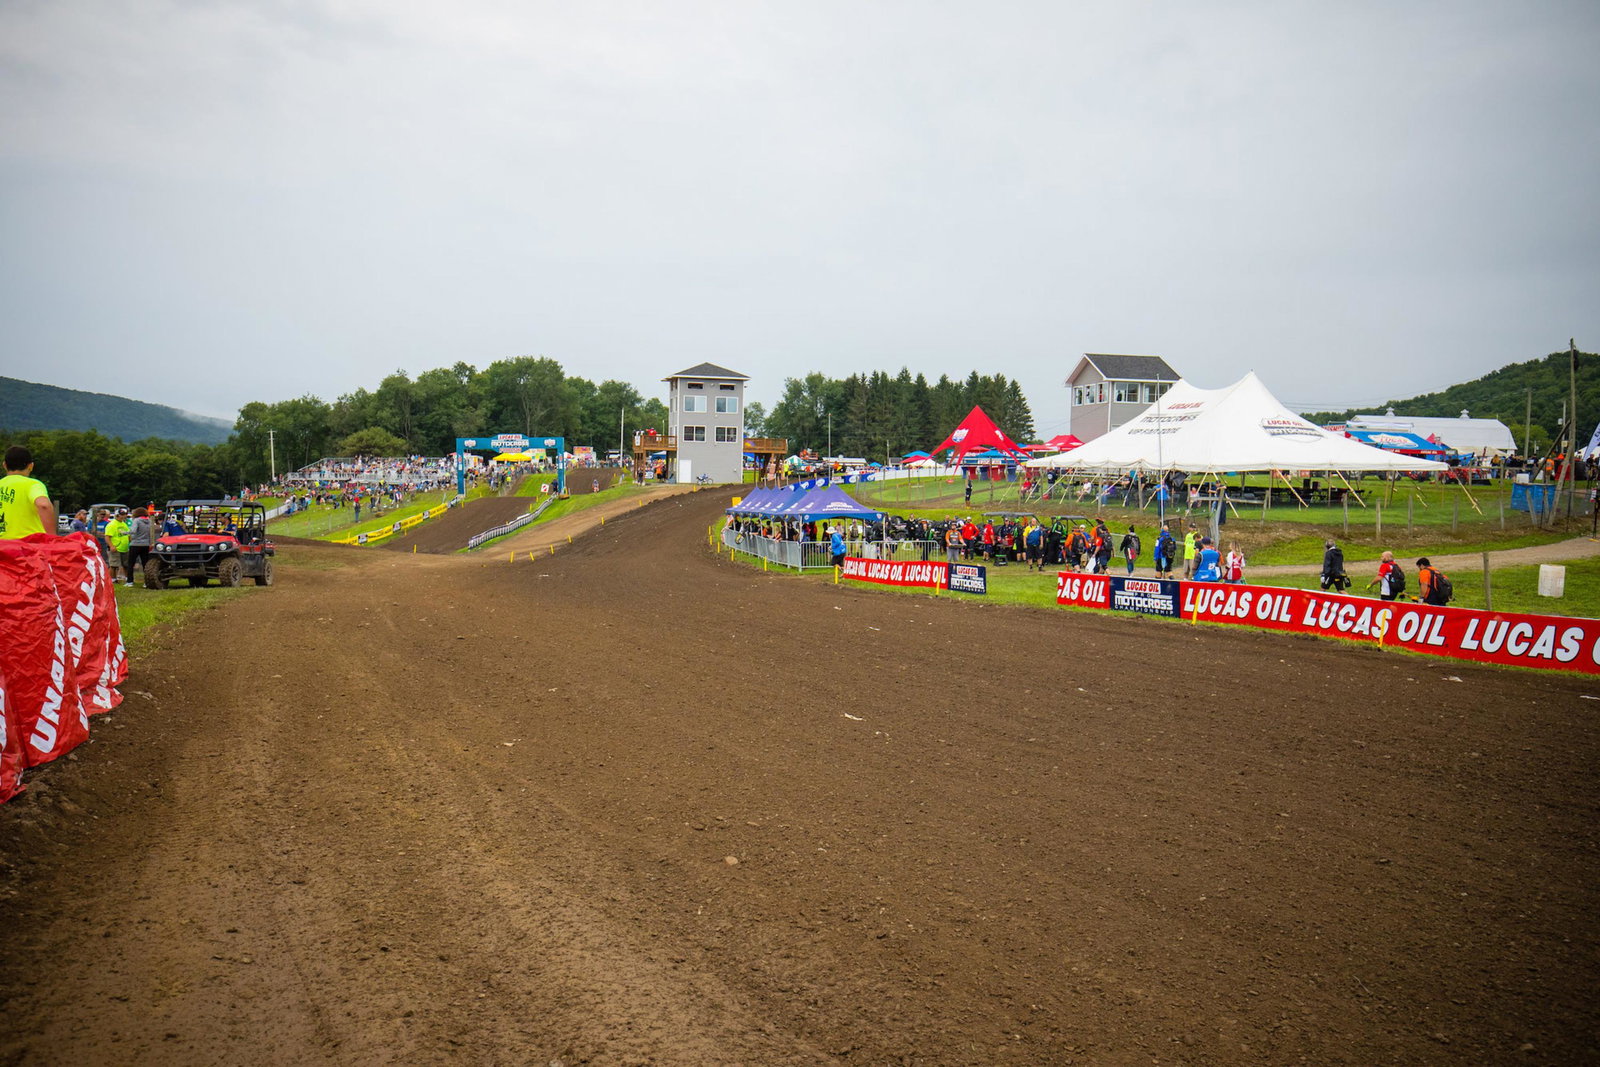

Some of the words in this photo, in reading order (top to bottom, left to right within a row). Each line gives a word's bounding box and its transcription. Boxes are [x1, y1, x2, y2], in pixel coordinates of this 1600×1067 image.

[868, 562, 891, 579] LUCAS
[891, 565, 904, 581] OIL
[905, 565, 930, 583] LUCAS
[932, 566, 946, 584] OIL
[957, 566, 969, 575] LUCAS
[969, 567, 978, 576] OIL
[951, 577, 985, 589] MOTOCROSS
[1126, 581, 1147, 592] LUCAS
[1148, 583, 1159, 593] OIL
[1083, 580, 1105, 603] OIL
[1115, 595, 1173, 610] MOTOCROSS
[1115, 605, 1174, 615] CHAMPIONSHIP
[1183, 588, 1252, 619] LUCAS
[1256, 593, 1292, 623] OIL
[1302, 599, 1393, 638] LUCAS
[1397, 611, 1446, 646] OIL
[1460, 618, 1585, 663] LUCAS
